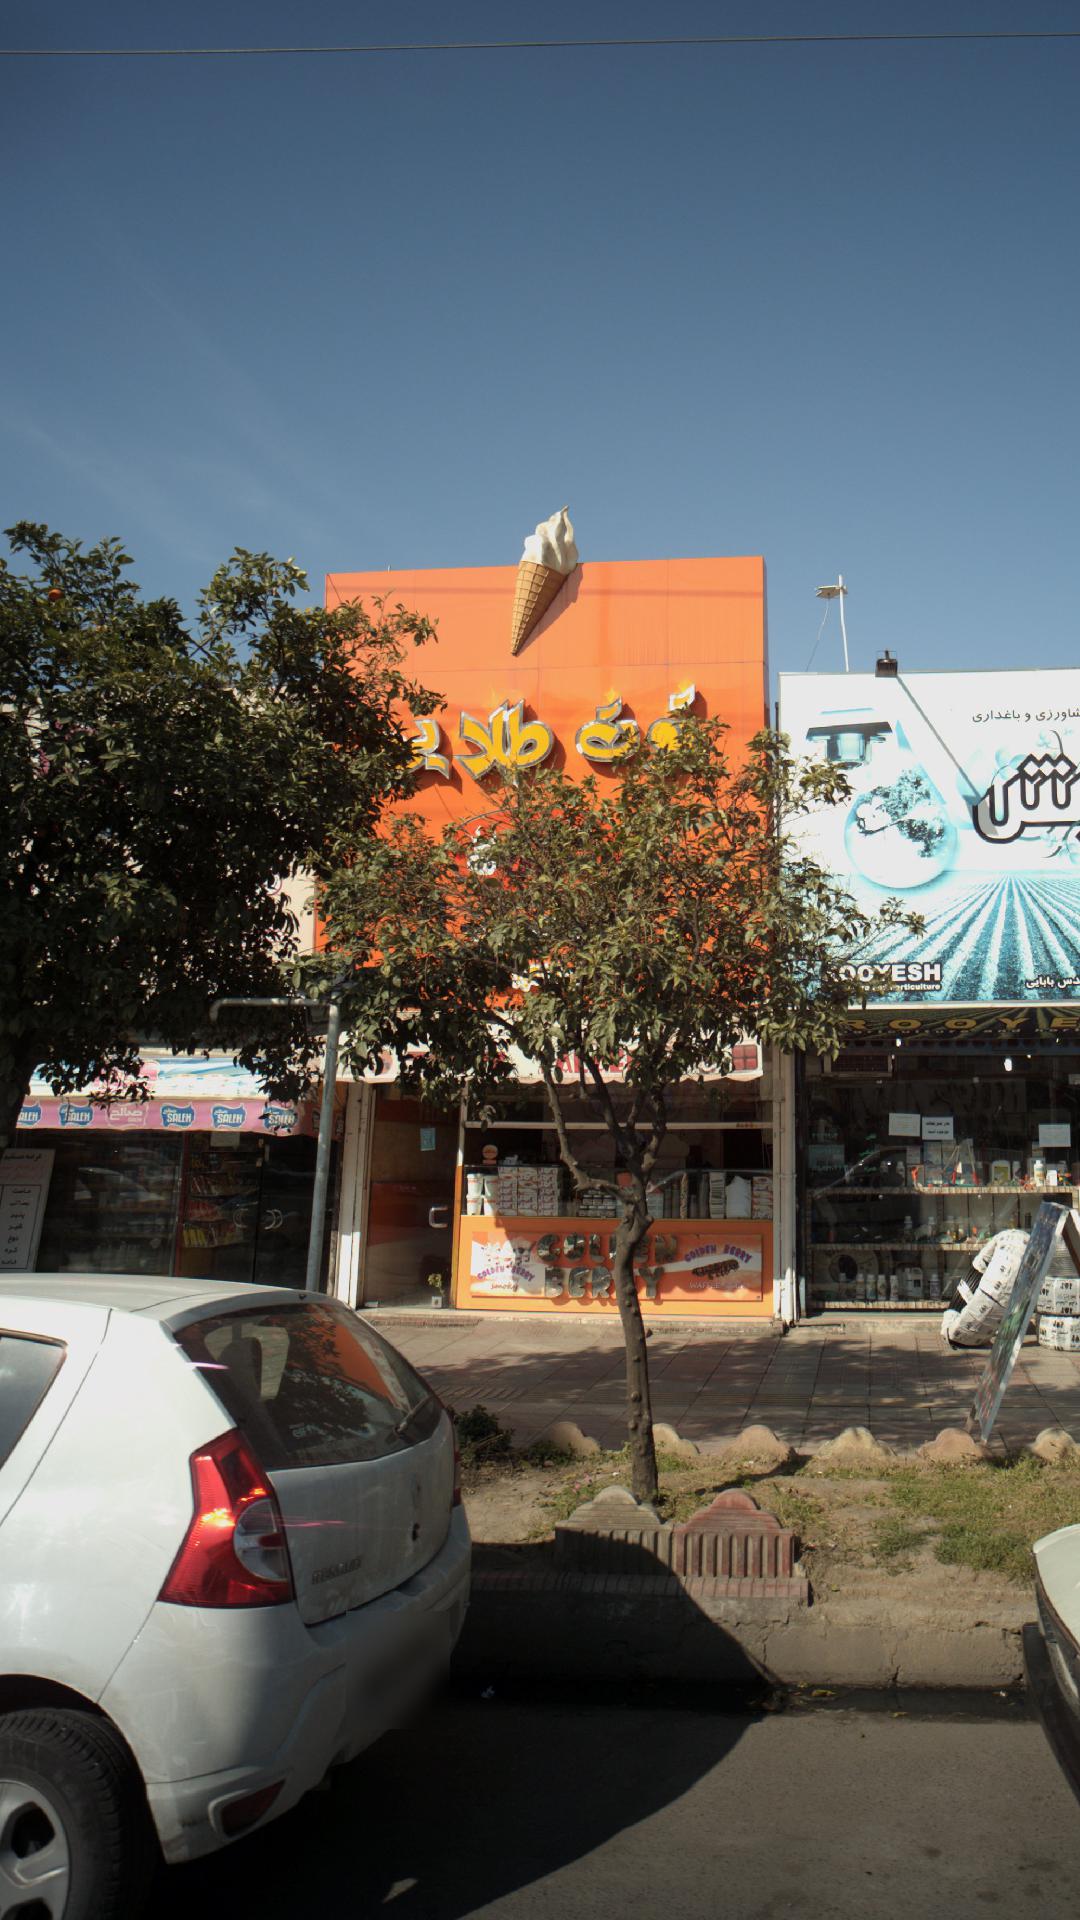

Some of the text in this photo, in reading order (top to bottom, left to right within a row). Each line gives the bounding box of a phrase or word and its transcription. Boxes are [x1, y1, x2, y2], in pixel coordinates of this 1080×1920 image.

[972, 709, 1021, 723] باغداری
[1035, 707, 1080, 722] شاورزی
[838, 962, 942, 983] OOYESH
[1025, 975, 1056, 989] بابایی
[18, 1111, 39, 1121] ALEH
[166, 1112, 192, 1123] SALEH
[217, 1113, 243, 1124] SALEH
[544, 1266, 665, 1299] BERY
